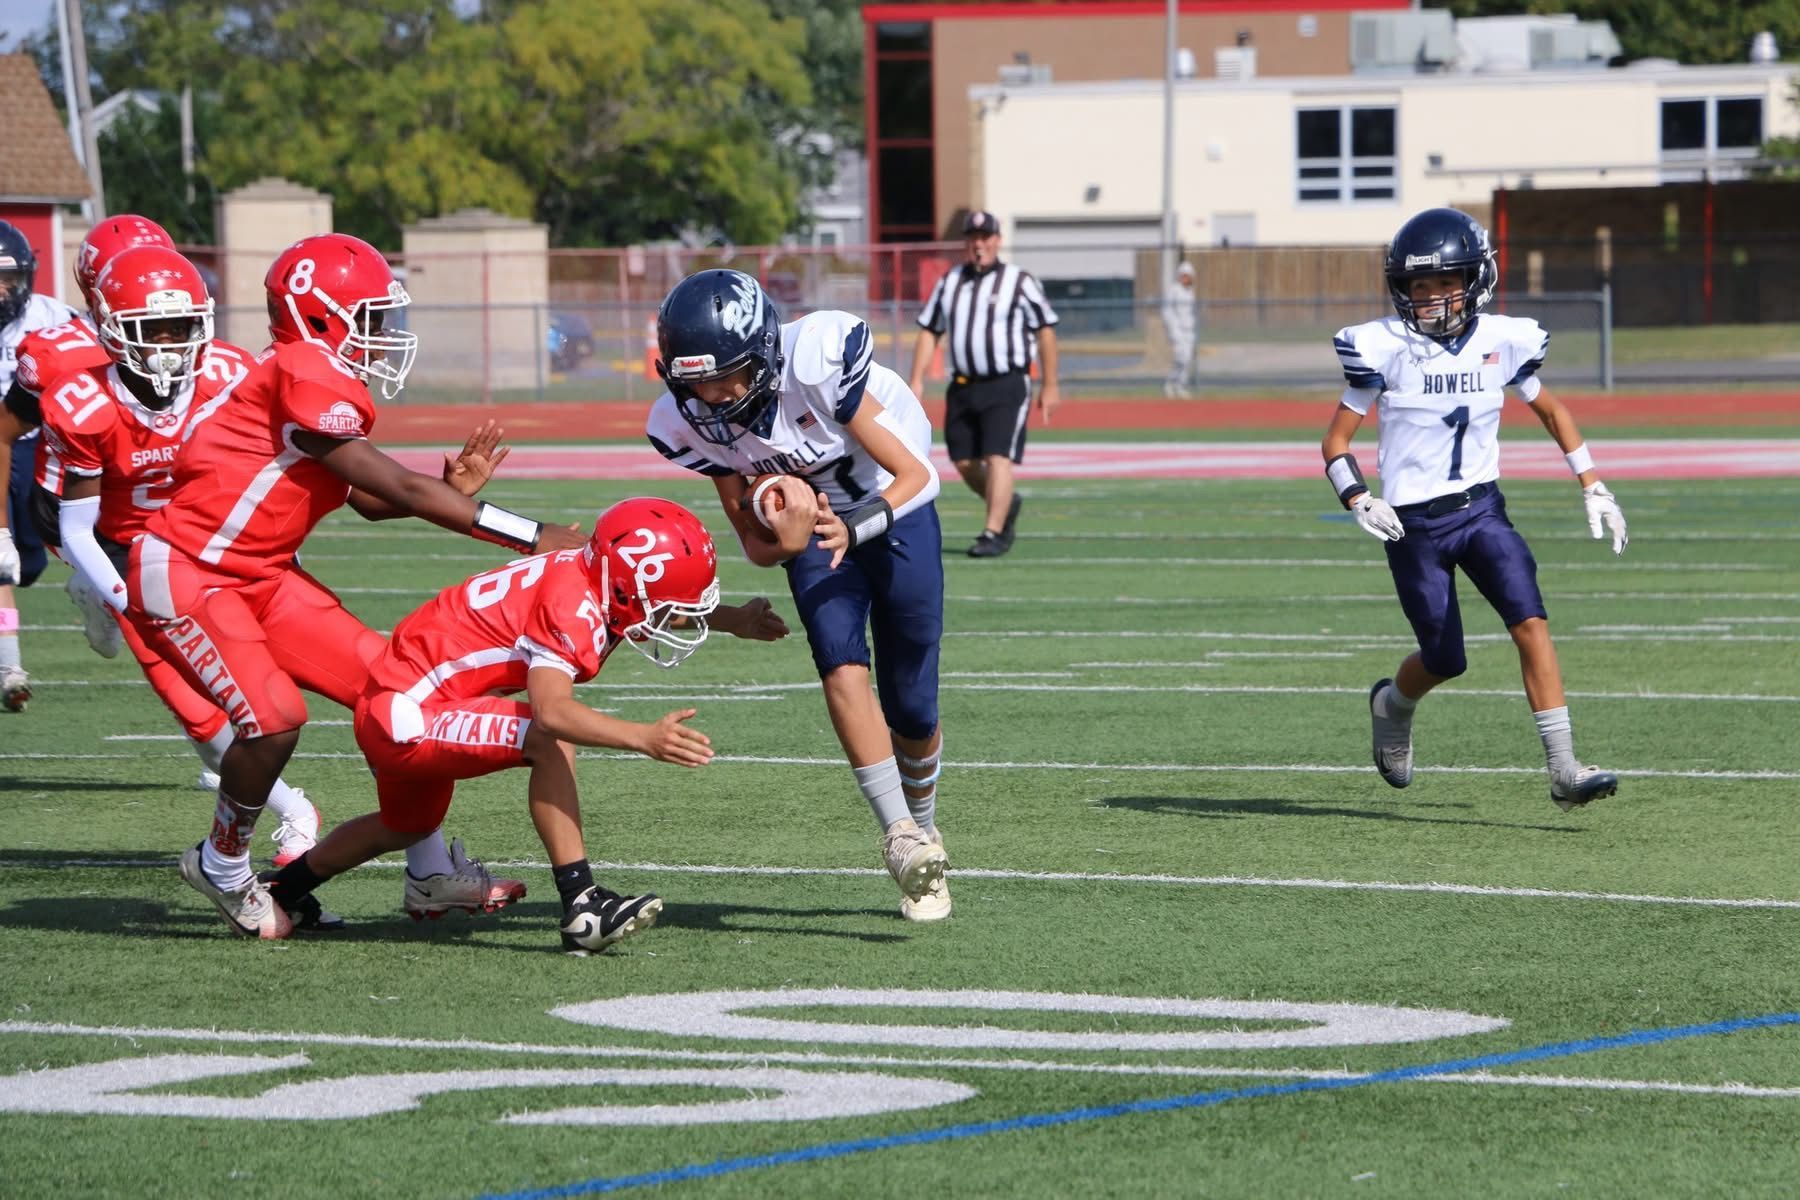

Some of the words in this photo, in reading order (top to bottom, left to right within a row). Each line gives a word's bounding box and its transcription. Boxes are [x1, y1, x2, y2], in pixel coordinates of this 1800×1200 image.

[289, 258, 316, 295] 8
[38, 323, 97, 352] 87
[54, 373, 111, 427] 21
[1423, 371, 1485, 395] HOWELL
[751, 440, 826, 474] HOWELL
[1441, 405, 1471, 481] 1
[617, 527, 676, 583] 26
[153, 617, 259, 740] PARTANS
